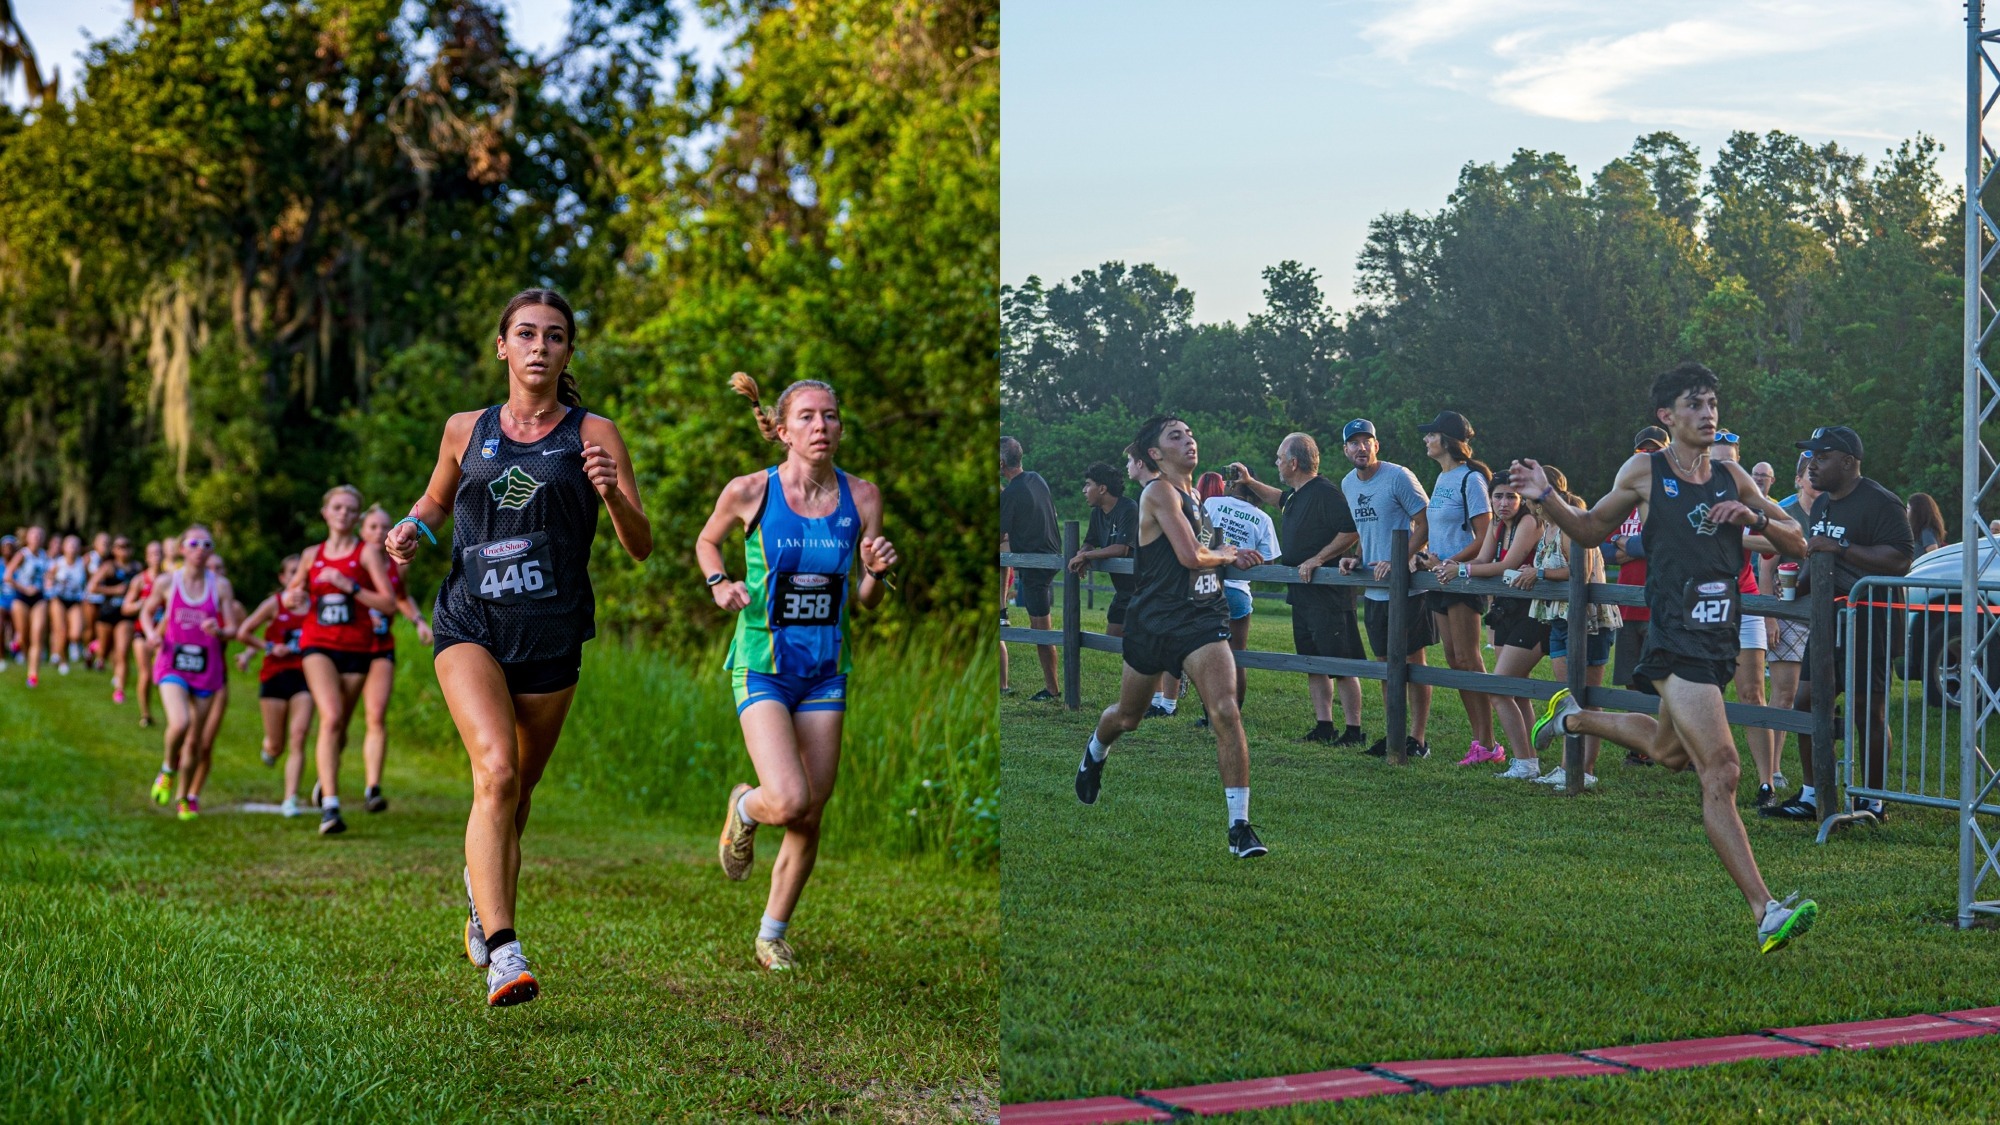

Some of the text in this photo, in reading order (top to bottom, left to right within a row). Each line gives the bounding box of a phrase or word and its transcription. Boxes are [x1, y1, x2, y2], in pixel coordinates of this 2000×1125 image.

[1217, 505, 1260, 525] JAY SQUAD
[1355, 507, 1377, 517] PBA
[483, 540, 529, 556] Track Shack
[777, 538, 850, 549] LAKEHAWKS
[480, 560, 544, 598] 446
[1195, 573, 1218, 594] 438
[321, 604, 349, 623] 471
[783, 593, 832, 619] 358
[1691, 599, 1730, 622] 427
